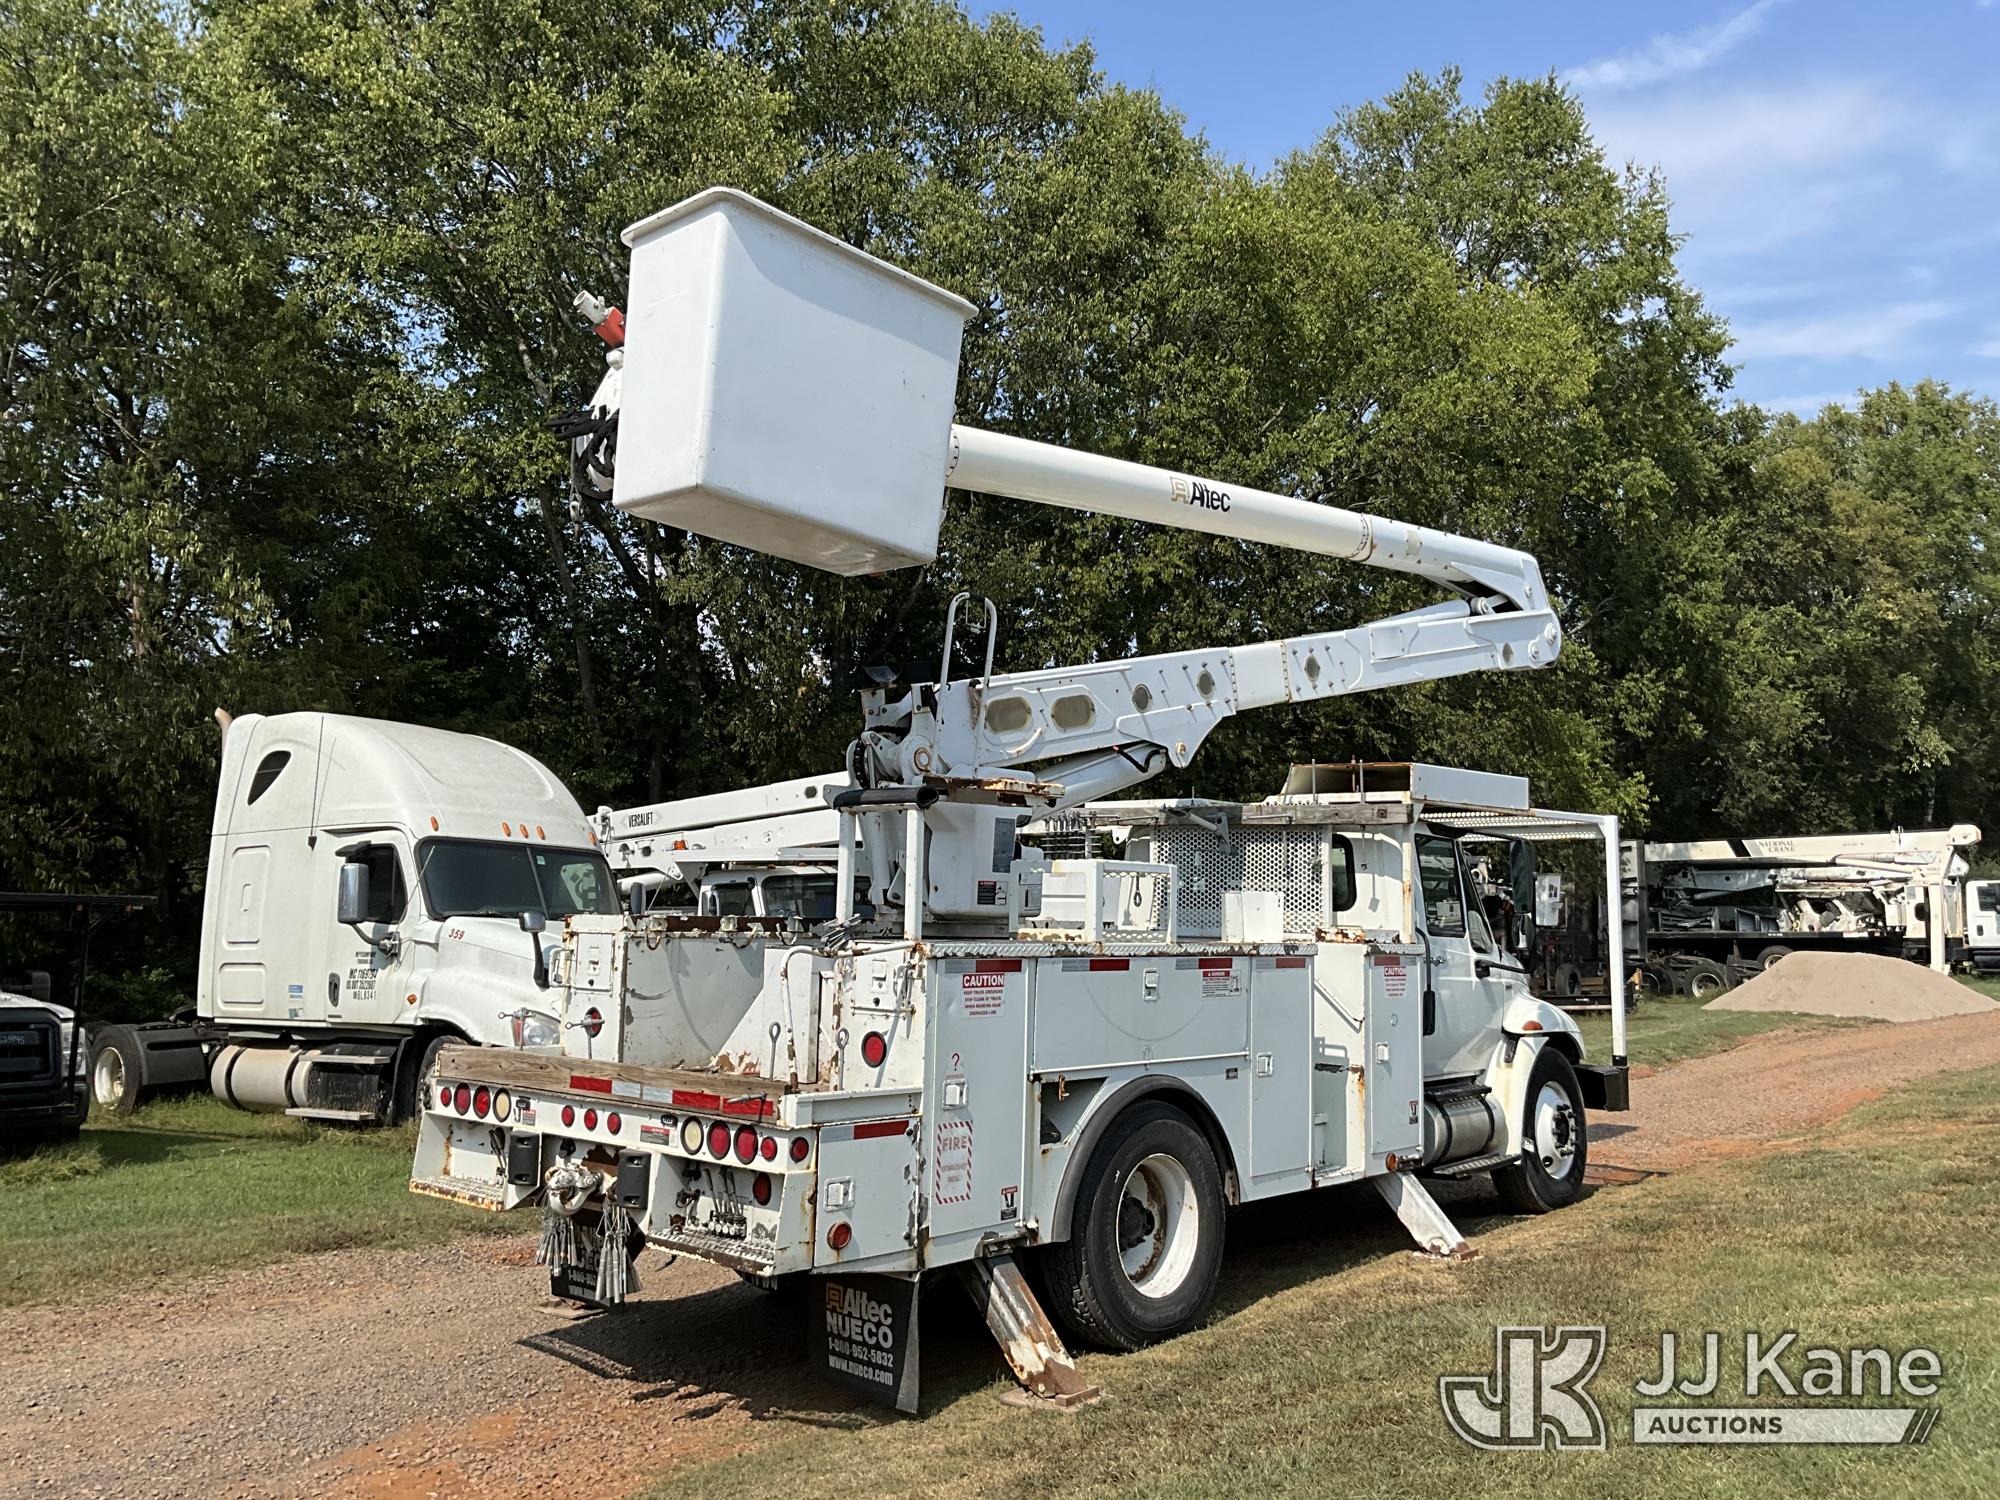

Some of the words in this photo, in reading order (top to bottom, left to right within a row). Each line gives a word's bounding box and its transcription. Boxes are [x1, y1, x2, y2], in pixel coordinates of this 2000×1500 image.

[1189, 482, 1231, 513] Altec
[628, 812, 653, 828] VERSALIFT
[1759, 840, 1793, 848] NATIONAL
[448, 928, 465, 940] 359
[1384, 967, 1406, 976] CAUTION
[963, 974, 1004, 987] CAUTION
[942, 1136, 968, 1151] FIRE
[843, 1287, 893, 1325] Altec
[826, 1310, 893, 1349] NUECO
[828, 1337, 894, 1368] 1-800-952-5832
[828, 1354, 893, 1386] www.nueco.com
